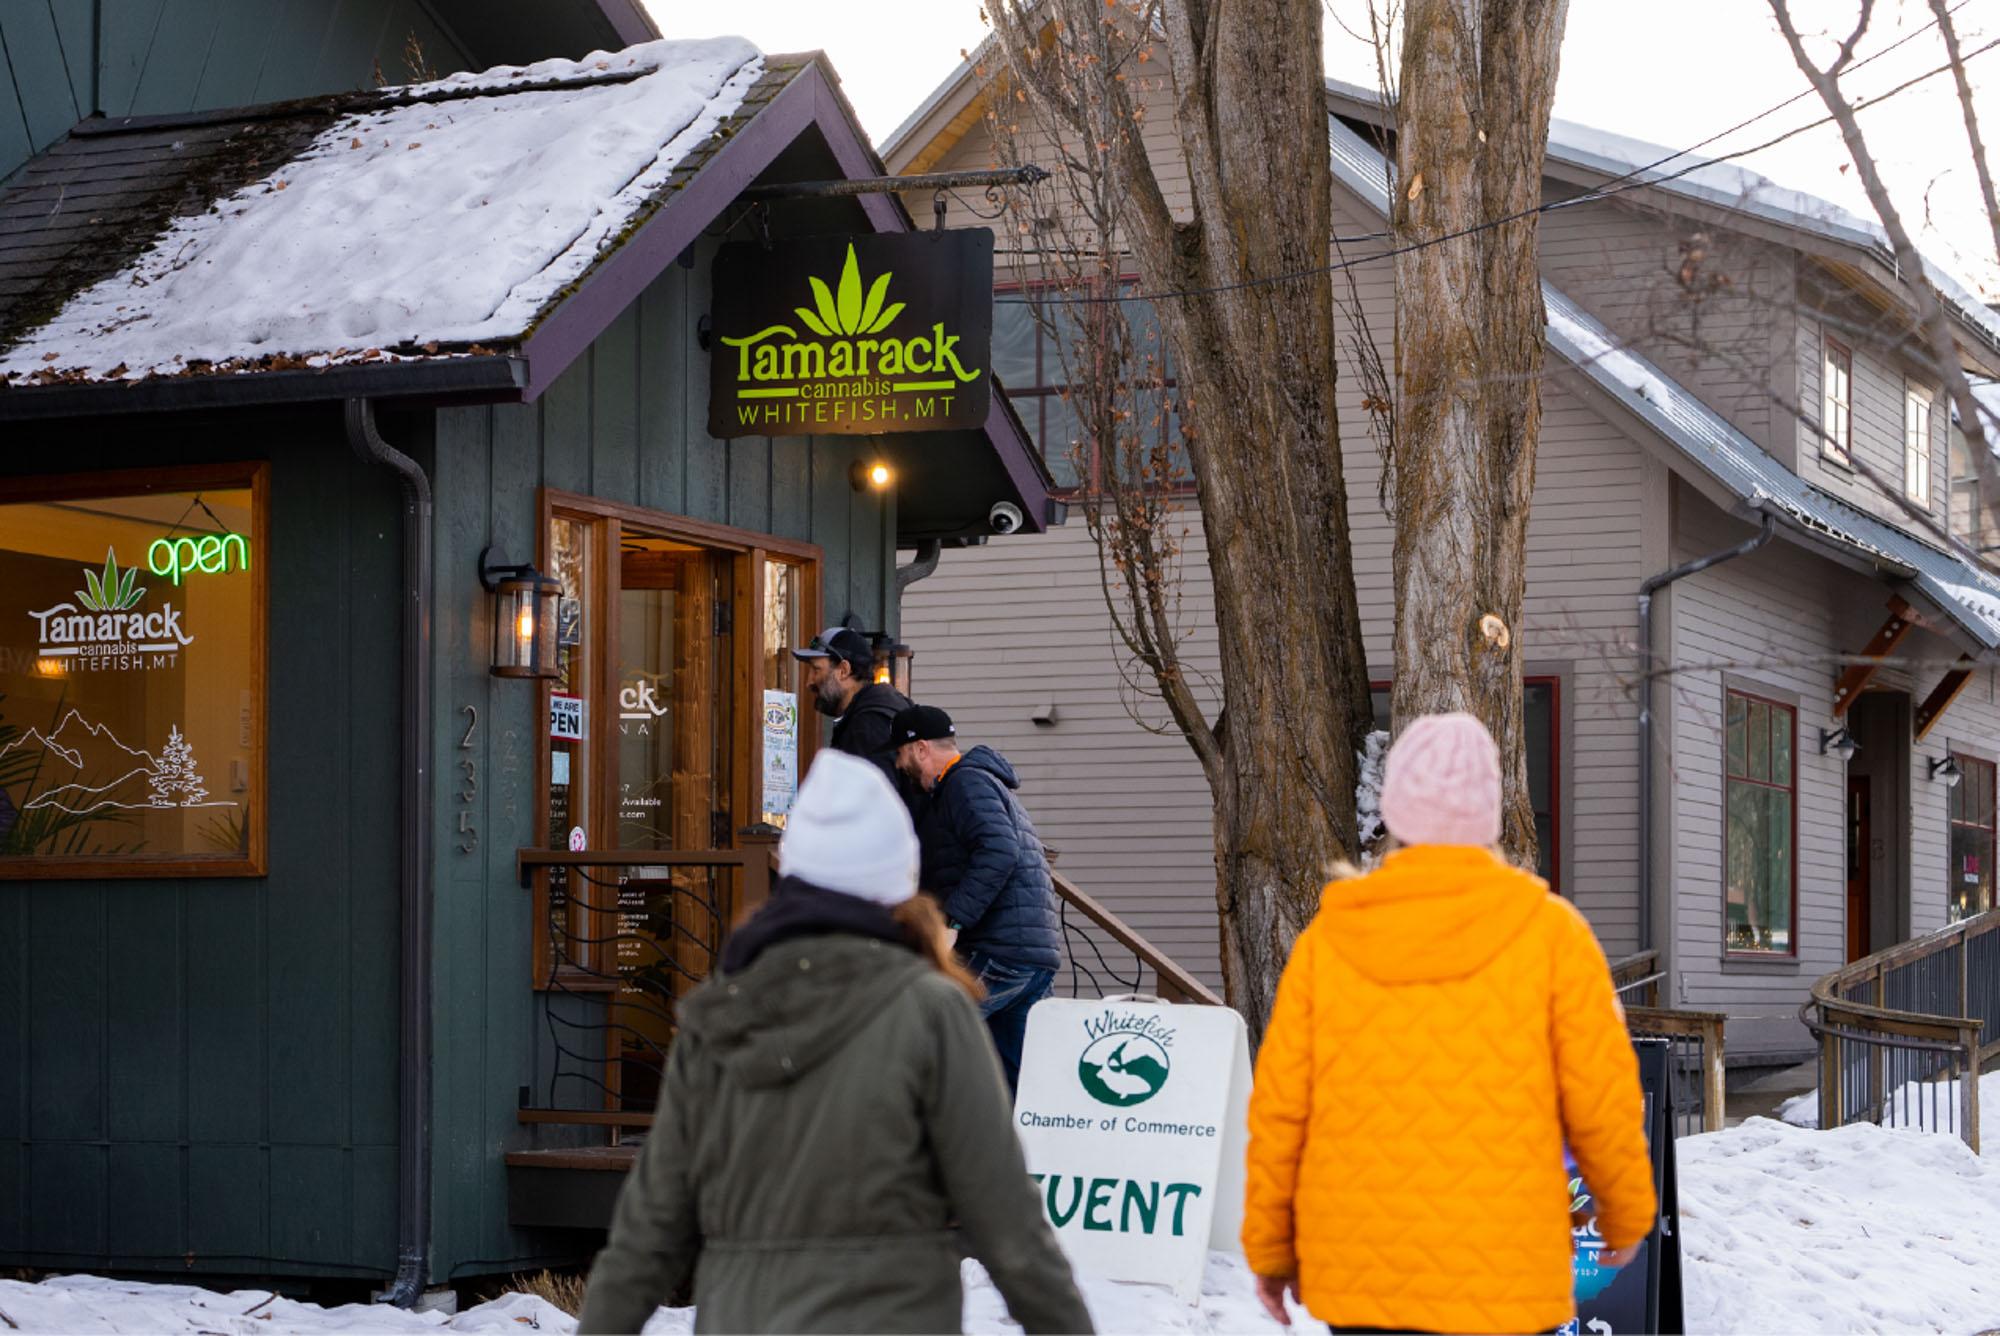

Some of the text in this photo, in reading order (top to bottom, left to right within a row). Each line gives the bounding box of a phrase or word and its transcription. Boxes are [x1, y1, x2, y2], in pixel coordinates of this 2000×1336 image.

[720, 322, 981, 383] Tamarack
[800, 380, 892, 399] cannabis
[148, 534, 248, 587] open
[27, 602, 195, 645] Tamarack
[79, 641, 138, 656] cannabis
[564, 702, 579, 712] ARE
[550, 711, 579, 734] PEN
[1084, 1009, 1175, 1048] Whitefish
[1020, 1111, 1216, 1137] Chamber of Commerce
